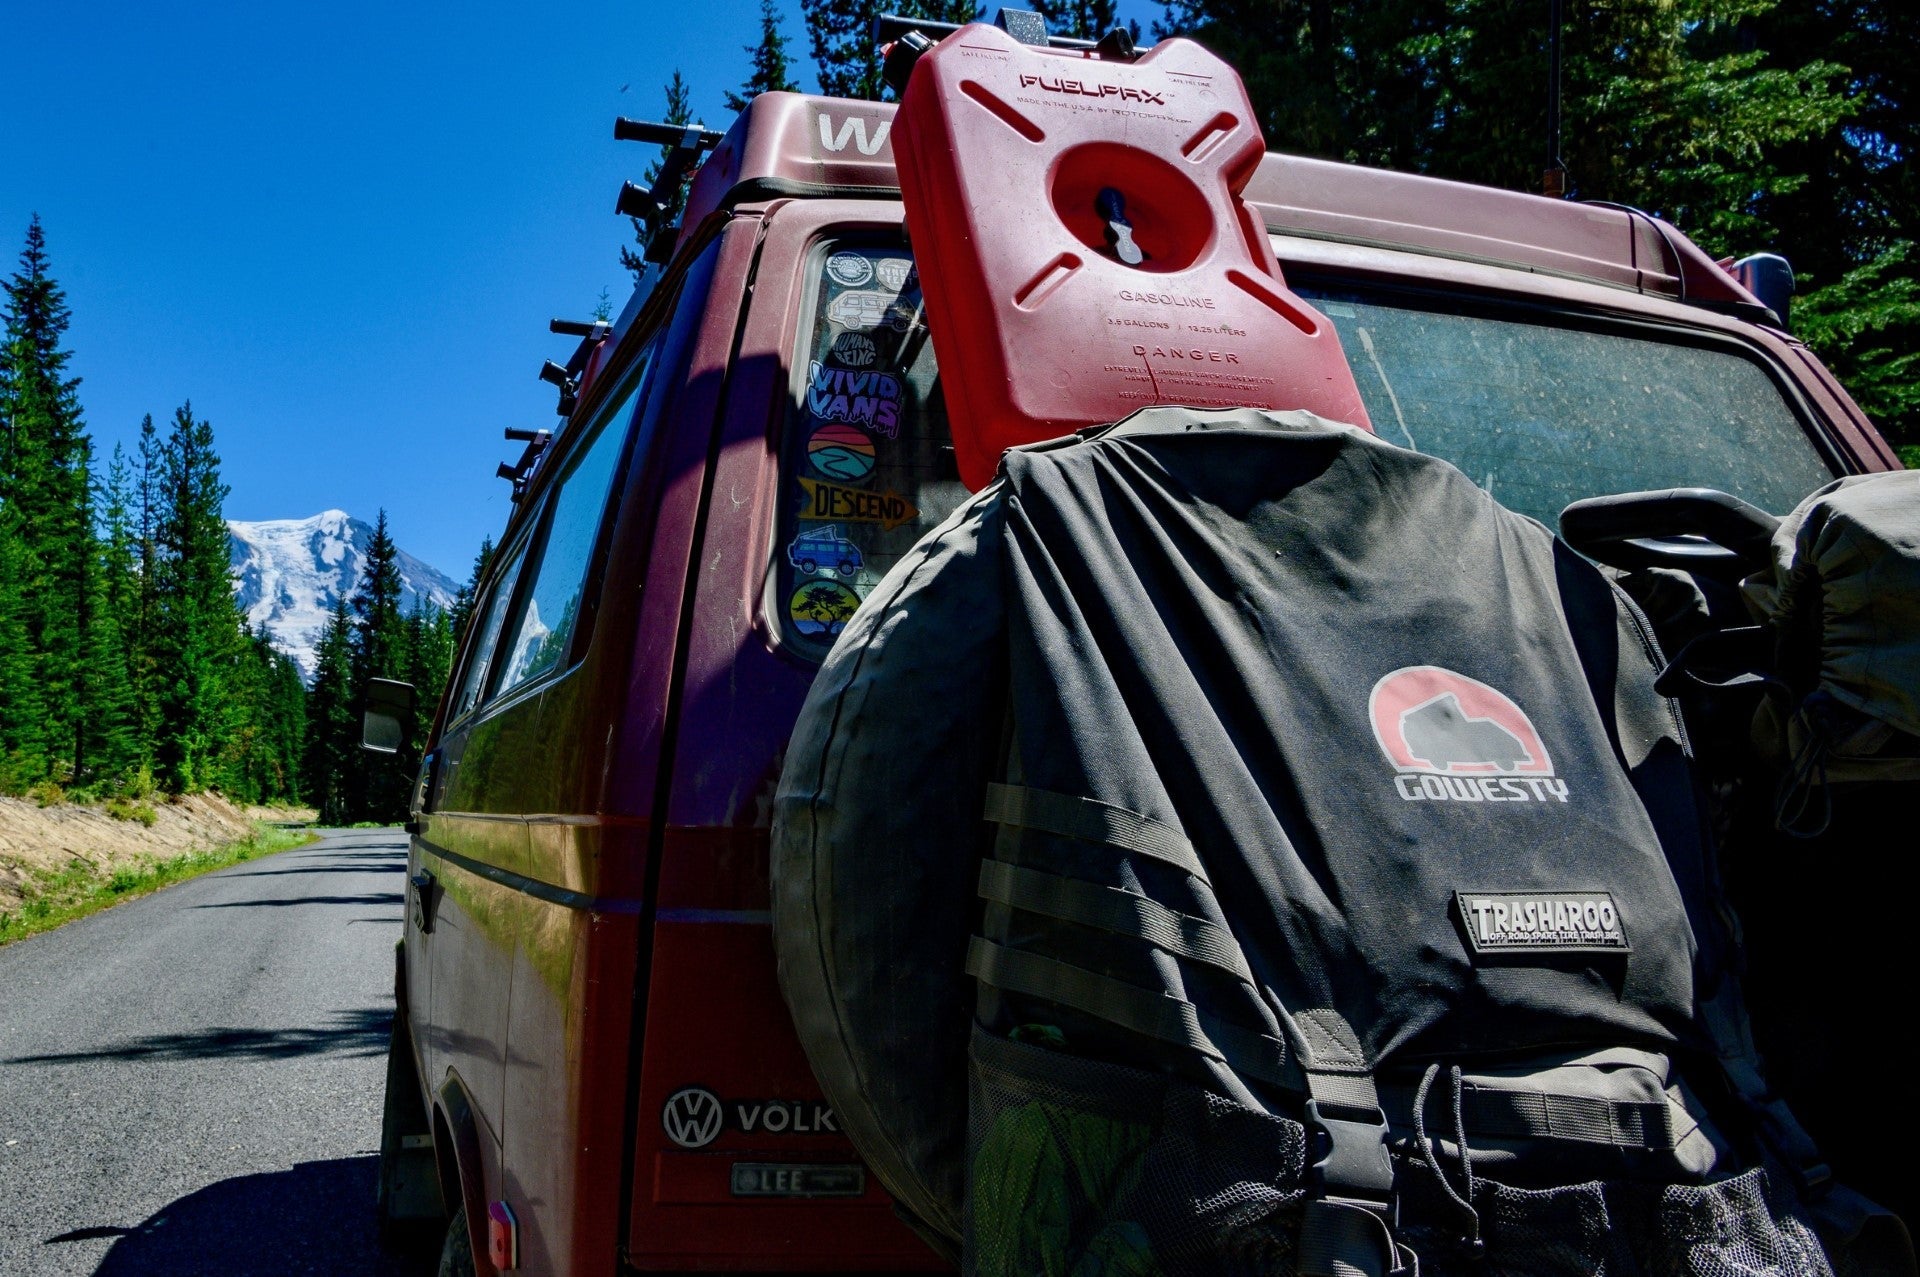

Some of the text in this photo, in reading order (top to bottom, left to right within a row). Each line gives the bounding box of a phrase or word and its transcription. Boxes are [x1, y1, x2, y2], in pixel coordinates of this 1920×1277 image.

[1019, 73, 1165, 106] FUELPAX
[1016, 97, 1041, 105] MADE
[1118, 290, 1216, 310] GASOLINE
[1124, 319, 1170, 330] GALLONS
[1188, 325, 1213, 334] 13.25
[1213, 327, 1247, 337] LITERS
[834, 349, 877, 366] BEING
[1132, 345, 1239, 364] DANGER
[810, 361, 899, 397] VIVID
[1104, 365, 1147, 374] EXTREMELY
[1118, 391, 1137, 399] KEEP
[809, 384, 899, 434] VANS
[815, 483, 906, 520] DESCEND
[1393, 775, 1570, 802] GOWESTY
[1471, 899, 1616, 941] TRASHAROO
[1489, 932, 1620, 941] OFF ROAD SPARE TIRE TRASH BAG
[738, 1104, 840, 1132] VOLK
